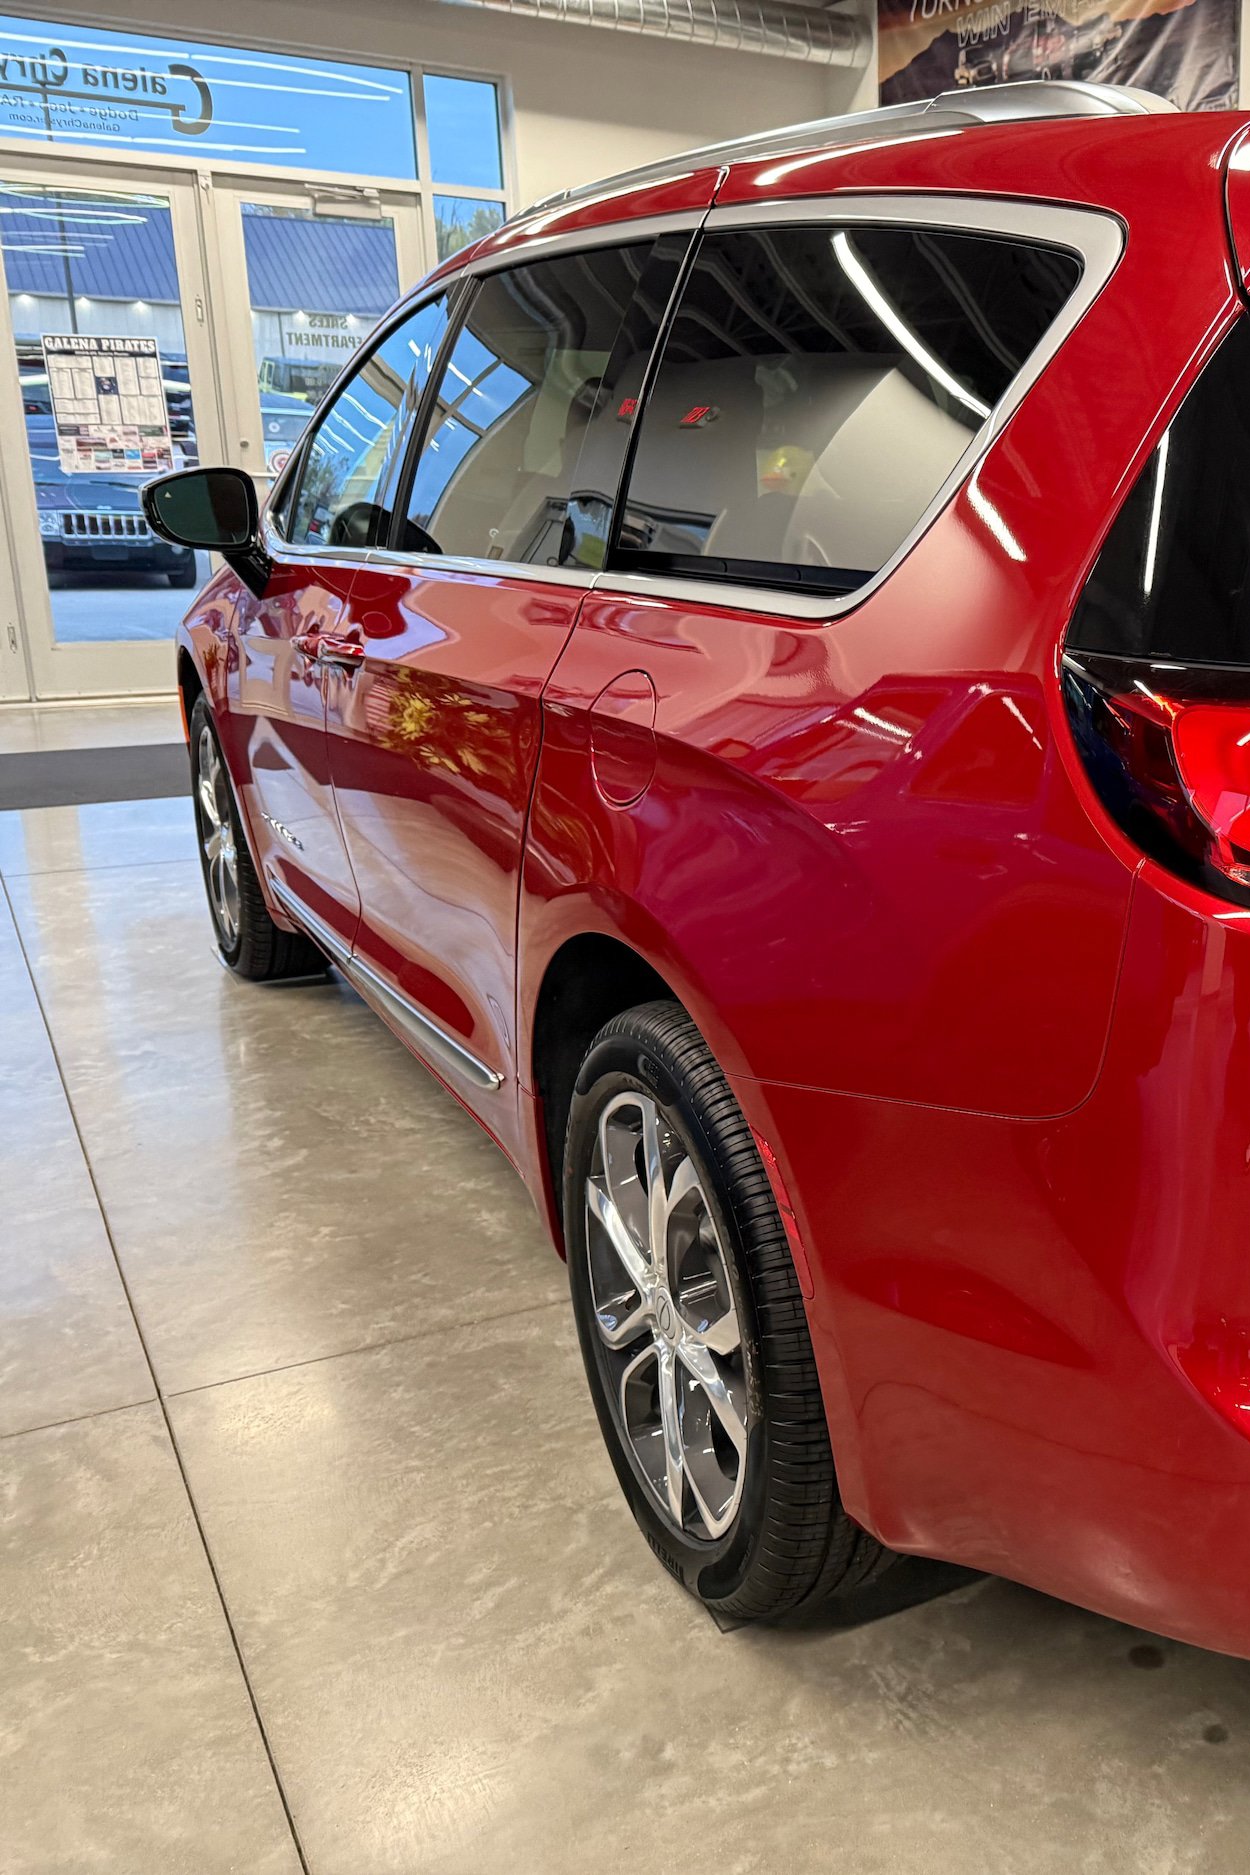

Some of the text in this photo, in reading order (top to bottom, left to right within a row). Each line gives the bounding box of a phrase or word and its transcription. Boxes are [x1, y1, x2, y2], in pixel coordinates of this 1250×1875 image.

[956, 2, 1011, 48] WIN
[44, 336, 156, 352] GALENA PIRATES
